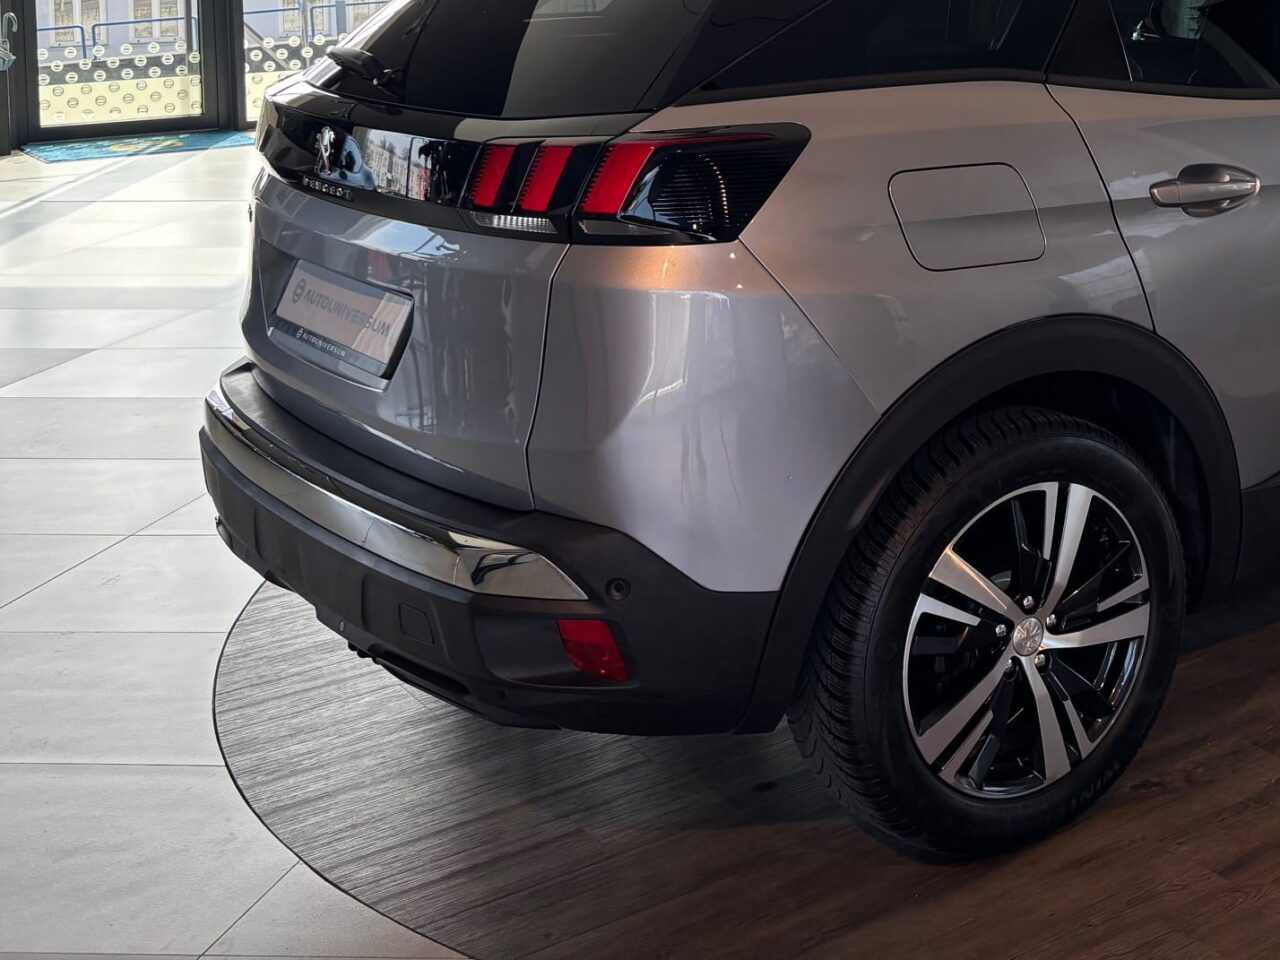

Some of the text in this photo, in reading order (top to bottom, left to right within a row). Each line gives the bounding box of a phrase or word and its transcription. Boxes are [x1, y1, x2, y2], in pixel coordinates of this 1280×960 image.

[303, 176, 351, 201] PEUGEOT
[303, 288, 391, 338] AUTOUNIVERSUM
[302, 332, 346, 358] AUTOUNIVERSUM
